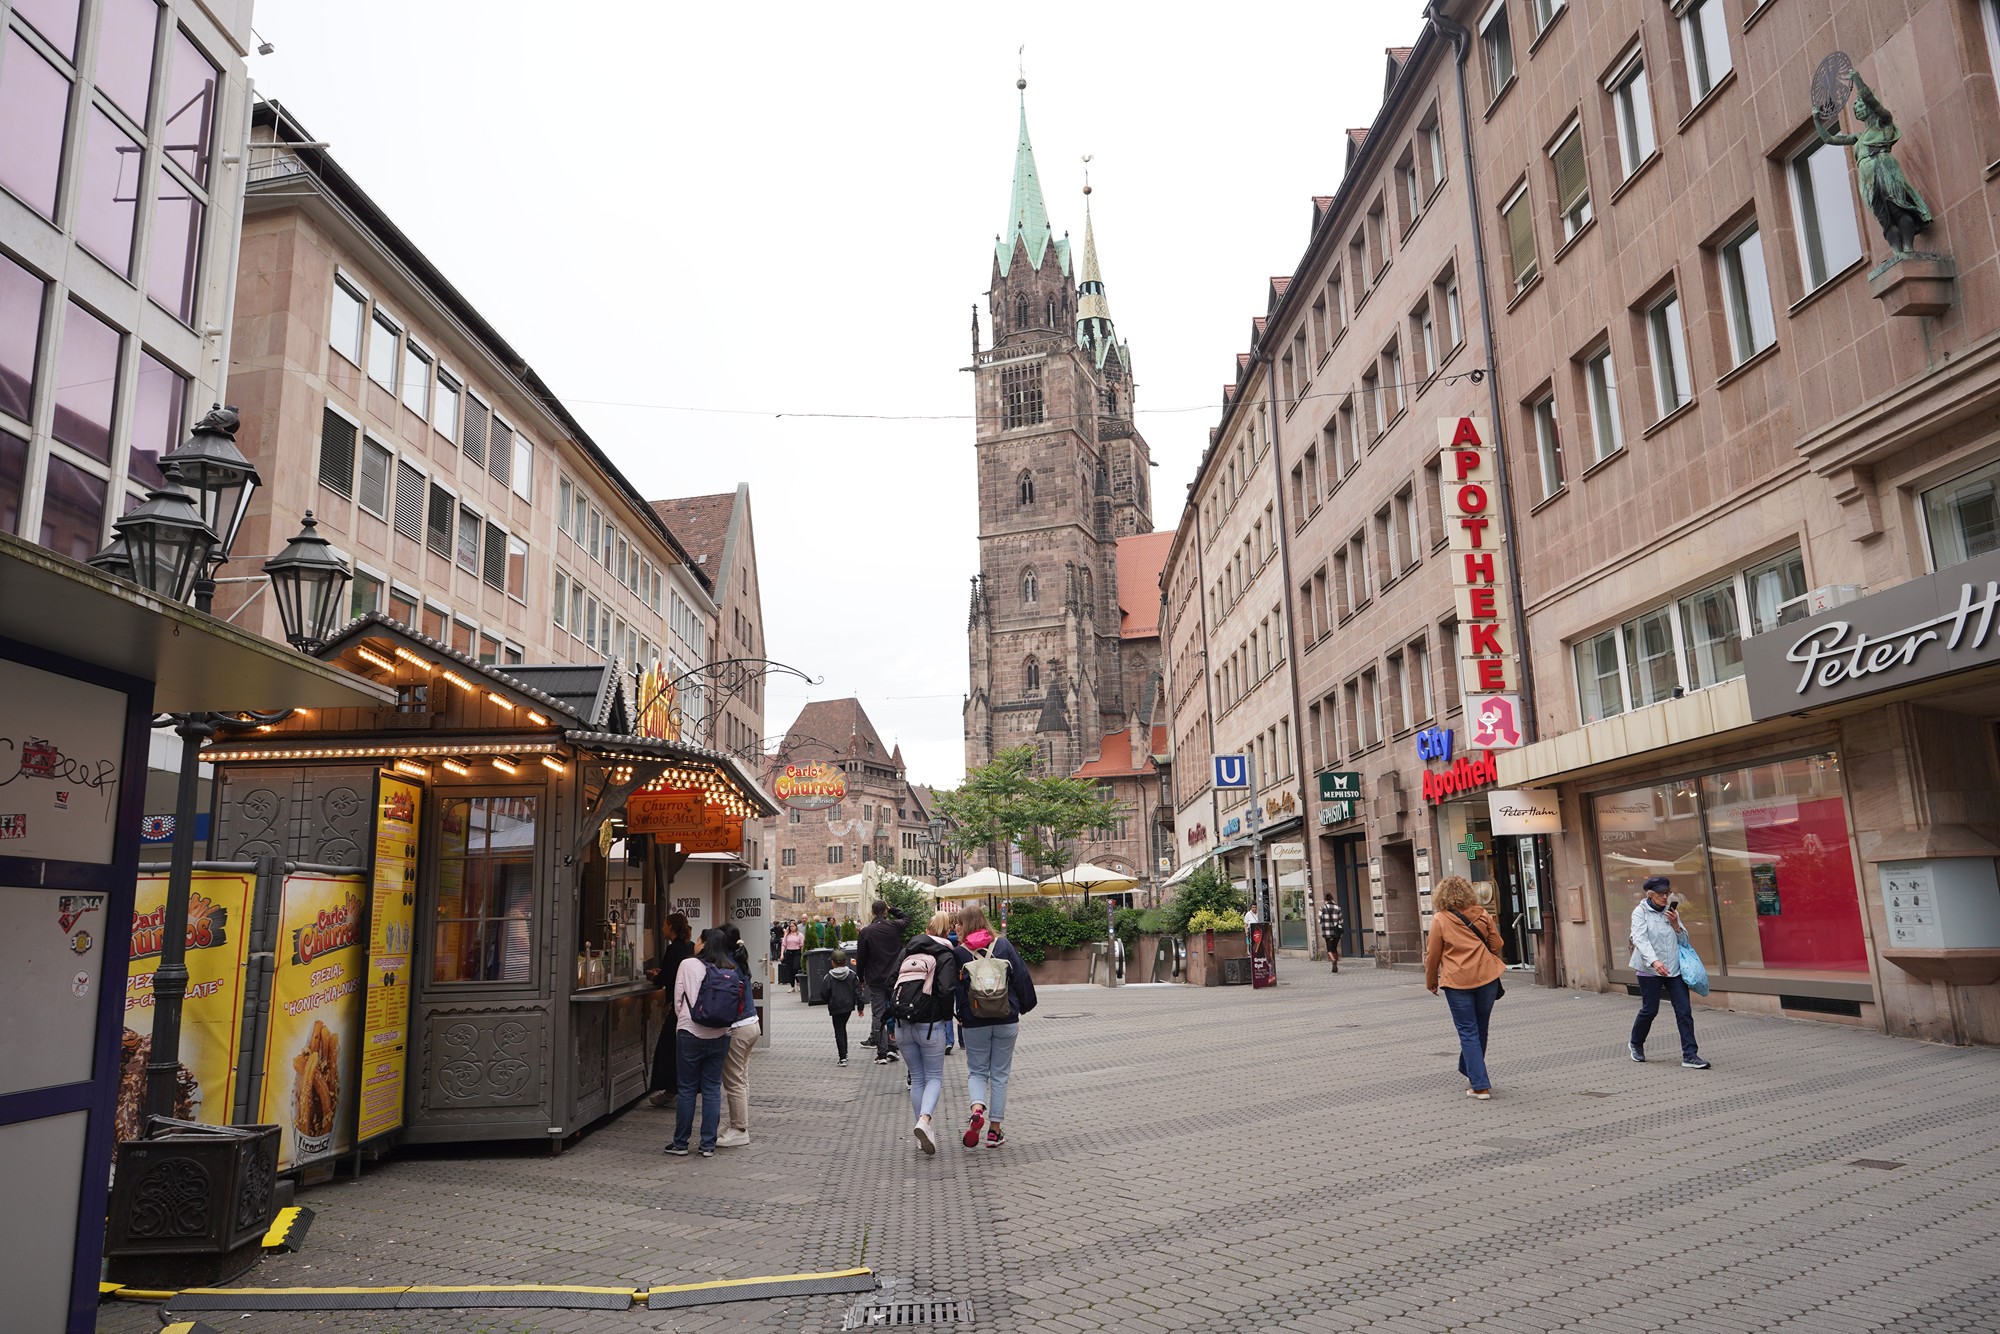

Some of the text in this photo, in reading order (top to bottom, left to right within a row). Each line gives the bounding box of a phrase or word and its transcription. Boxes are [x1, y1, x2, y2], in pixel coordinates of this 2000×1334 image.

[1451, 417, 1506, 690] APOTHEKE
[1785, 581, 2000, 693] Peter H
[1416, 726, 1453, 762] City
[786, 764, 823, 778] Carlo's
[1221, 759, 1241, 783] U
[1423, 750, 1497, 805] Apothek
[775, 776, 846, 799] Churros
[1324, 790, 1359, 798] MEPHISTO
[642, 799, 690, 813] Churros
[1319, 804, 1342, 826] MEPHISTO
[1499, 805, 1558, 817] Peter Hahn
[633, 812, 697, 826] Schoki-Mix
[1273, 845, 1302, 858] Optiker
[317, 905, 348, 930] Carlo's
[310, 963, 345, 987] SPEZIAL
